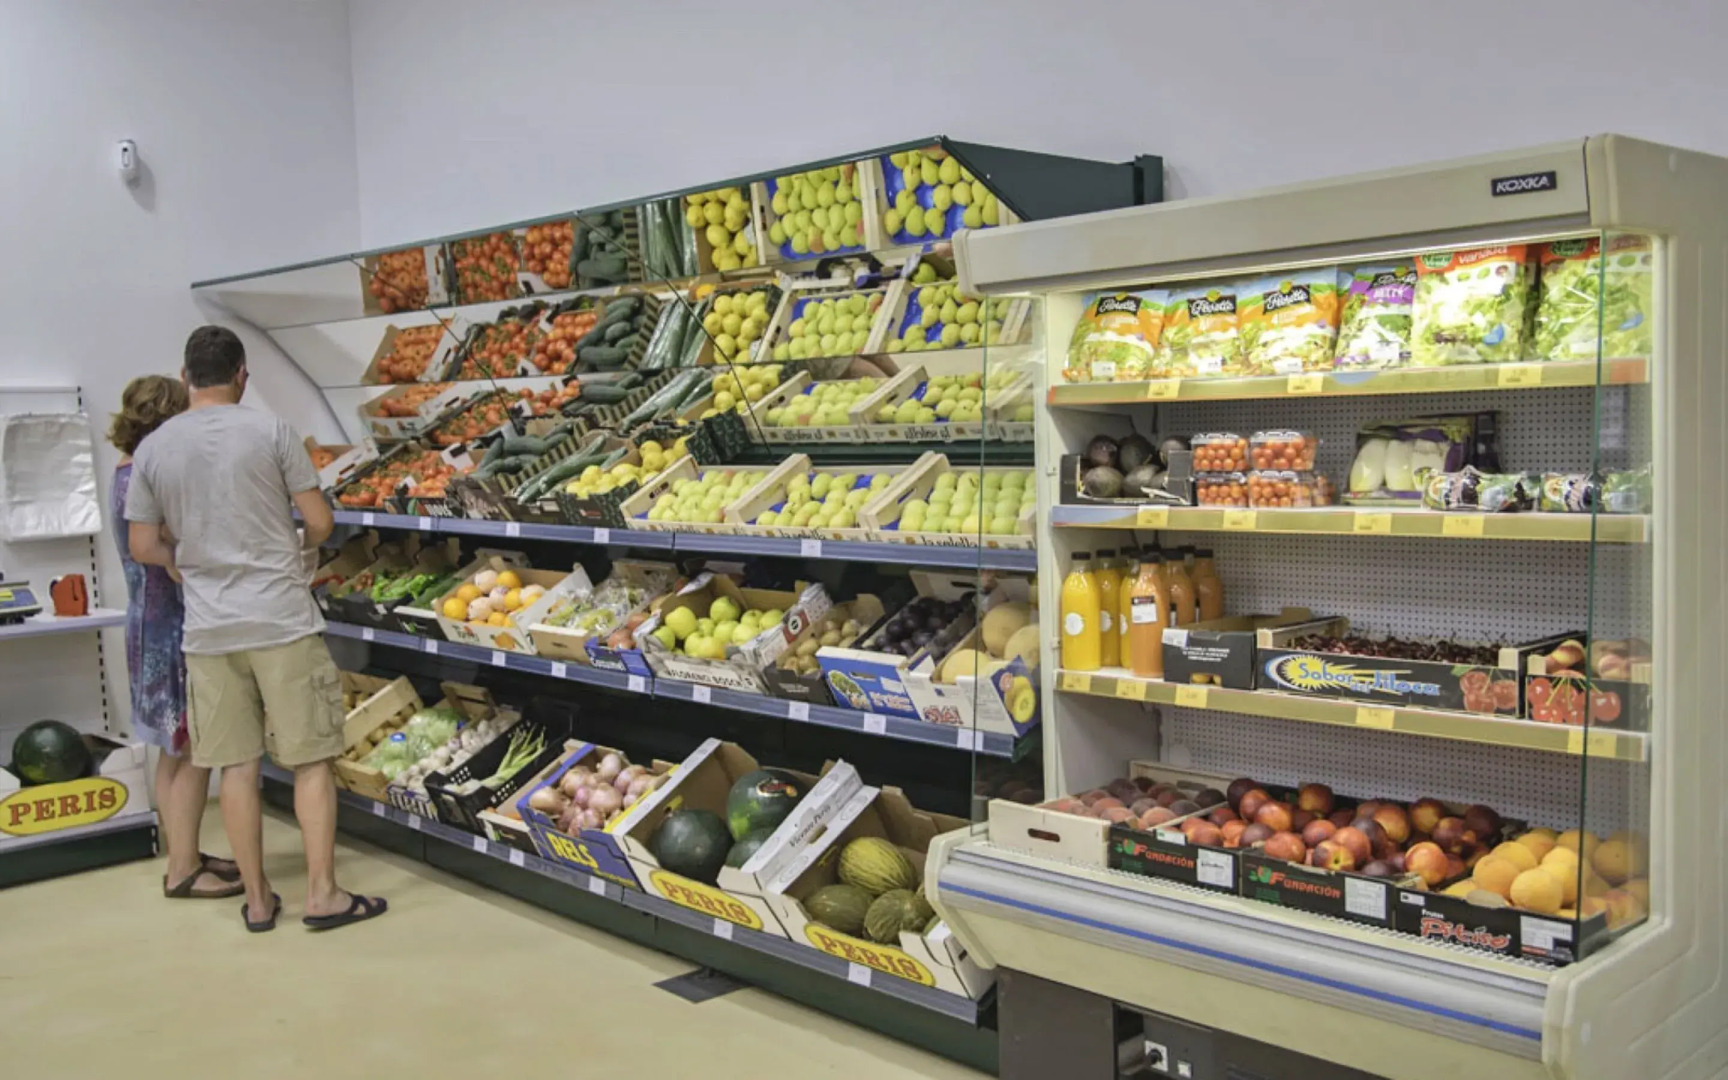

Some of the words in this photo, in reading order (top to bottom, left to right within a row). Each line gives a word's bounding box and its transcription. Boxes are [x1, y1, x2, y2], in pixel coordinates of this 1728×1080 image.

[1496, 176, 1550, 193] KOXKA
[1098, 299, 1138, 313] Florette
[1190, 299, 1235, 317] Florette
[1266, 289, 1309, 310] Florette
[1298, 662, 1352, 683] Sabor
[1371, 670, 1442, 696] Jiloca
[8, 786, 117, 827] PERIS
[659, 878, 752, 924] PERIS
[813, 931, 923, 981] PERIS
